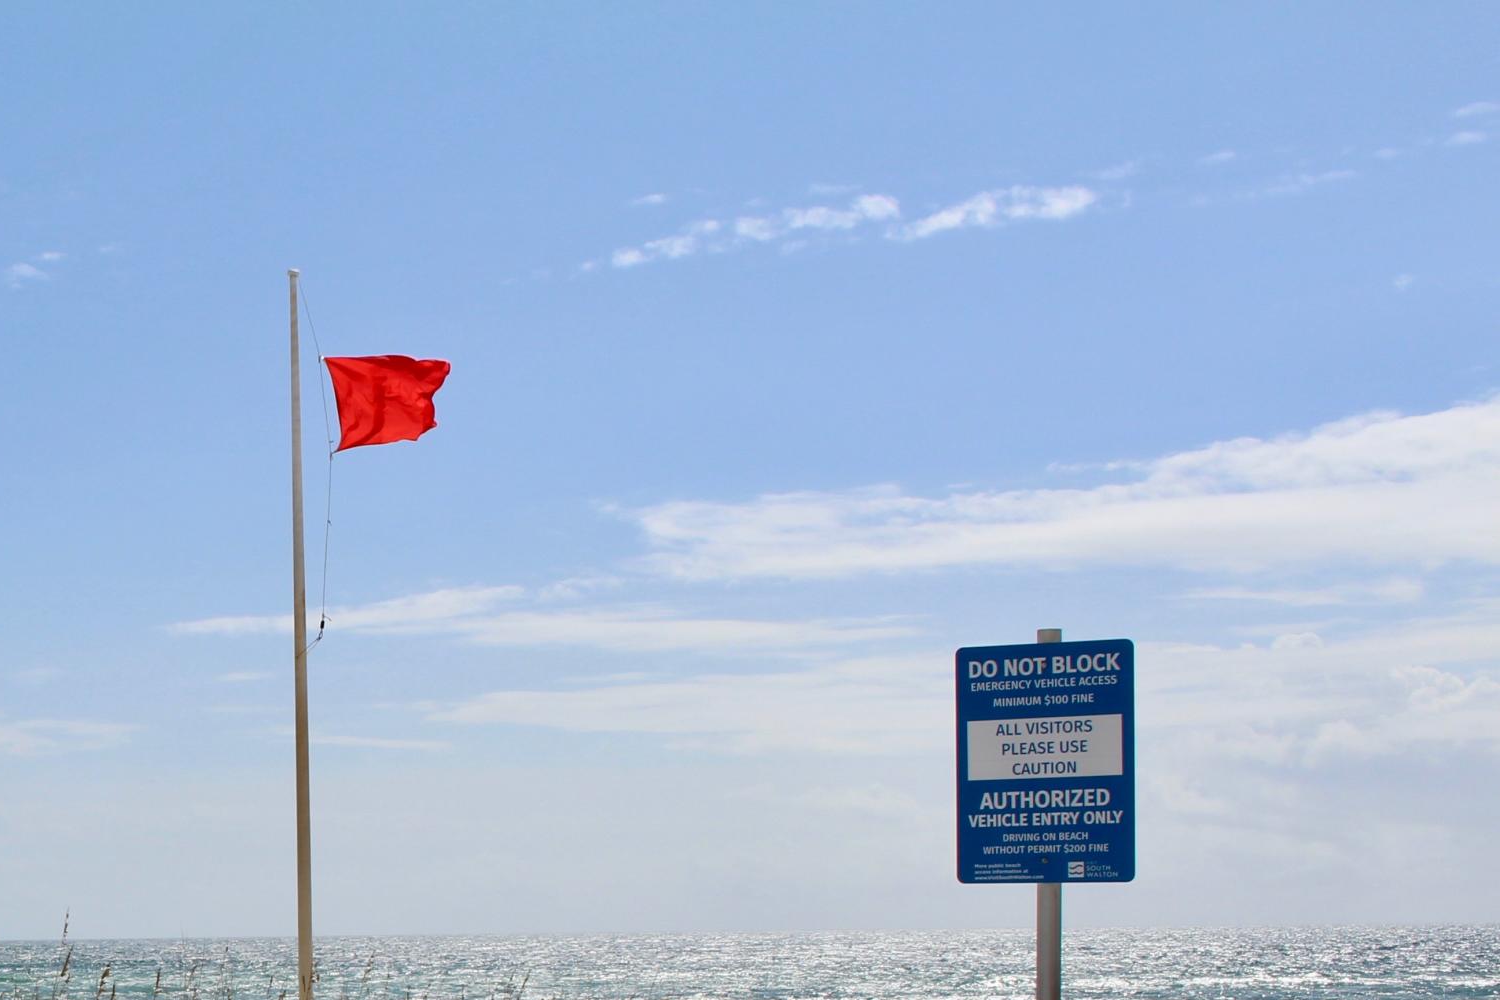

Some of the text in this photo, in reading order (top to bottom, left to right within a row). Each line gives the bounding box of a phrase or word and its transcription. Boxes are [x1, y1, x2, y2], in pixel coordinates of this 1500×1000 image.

[969, 652, 1120, 678] DO NOT BLOCK
[971, 675, 1117, 692] EMERGENCY VEHICLE ACCESS
[993, 693, 1094, 707] MINIMUM $100 FINE
[996, 720, 1092, 736] ALL VISITORS
[1002, 740, 1087, 755] PLEASE USE
[1013, 761, 1077, 775] CAUTION
[980, 788, 1110, 810] AUTHORIZED
[969, 810, 1123, 827] VEHICLE ENTRY ONLY
[1003, 832, 1088, 842] DRIVING ON BEACH
[983, 844, 1109, 854] WITHOUT PERMIT $200 FINE
